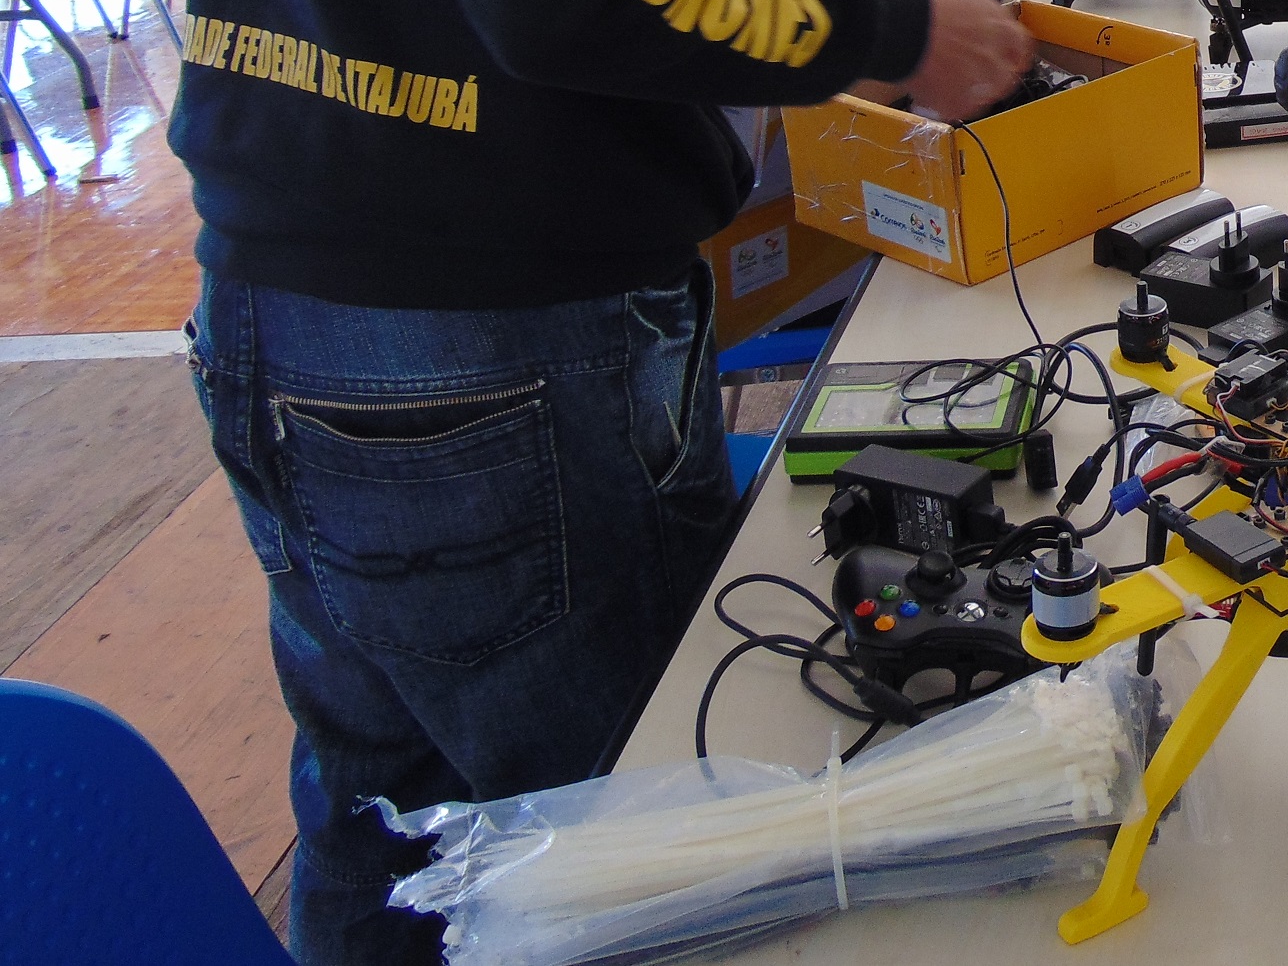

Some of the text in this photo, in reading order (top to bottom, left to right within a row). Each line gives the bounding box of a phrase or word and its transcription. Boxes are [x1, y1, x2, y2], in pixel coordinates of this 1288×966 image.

[230, 24, 318, 94] FEDERAL
[321, 48, 347, 103] DE
[346, 58, 479, 133] ITAJUBÁ
